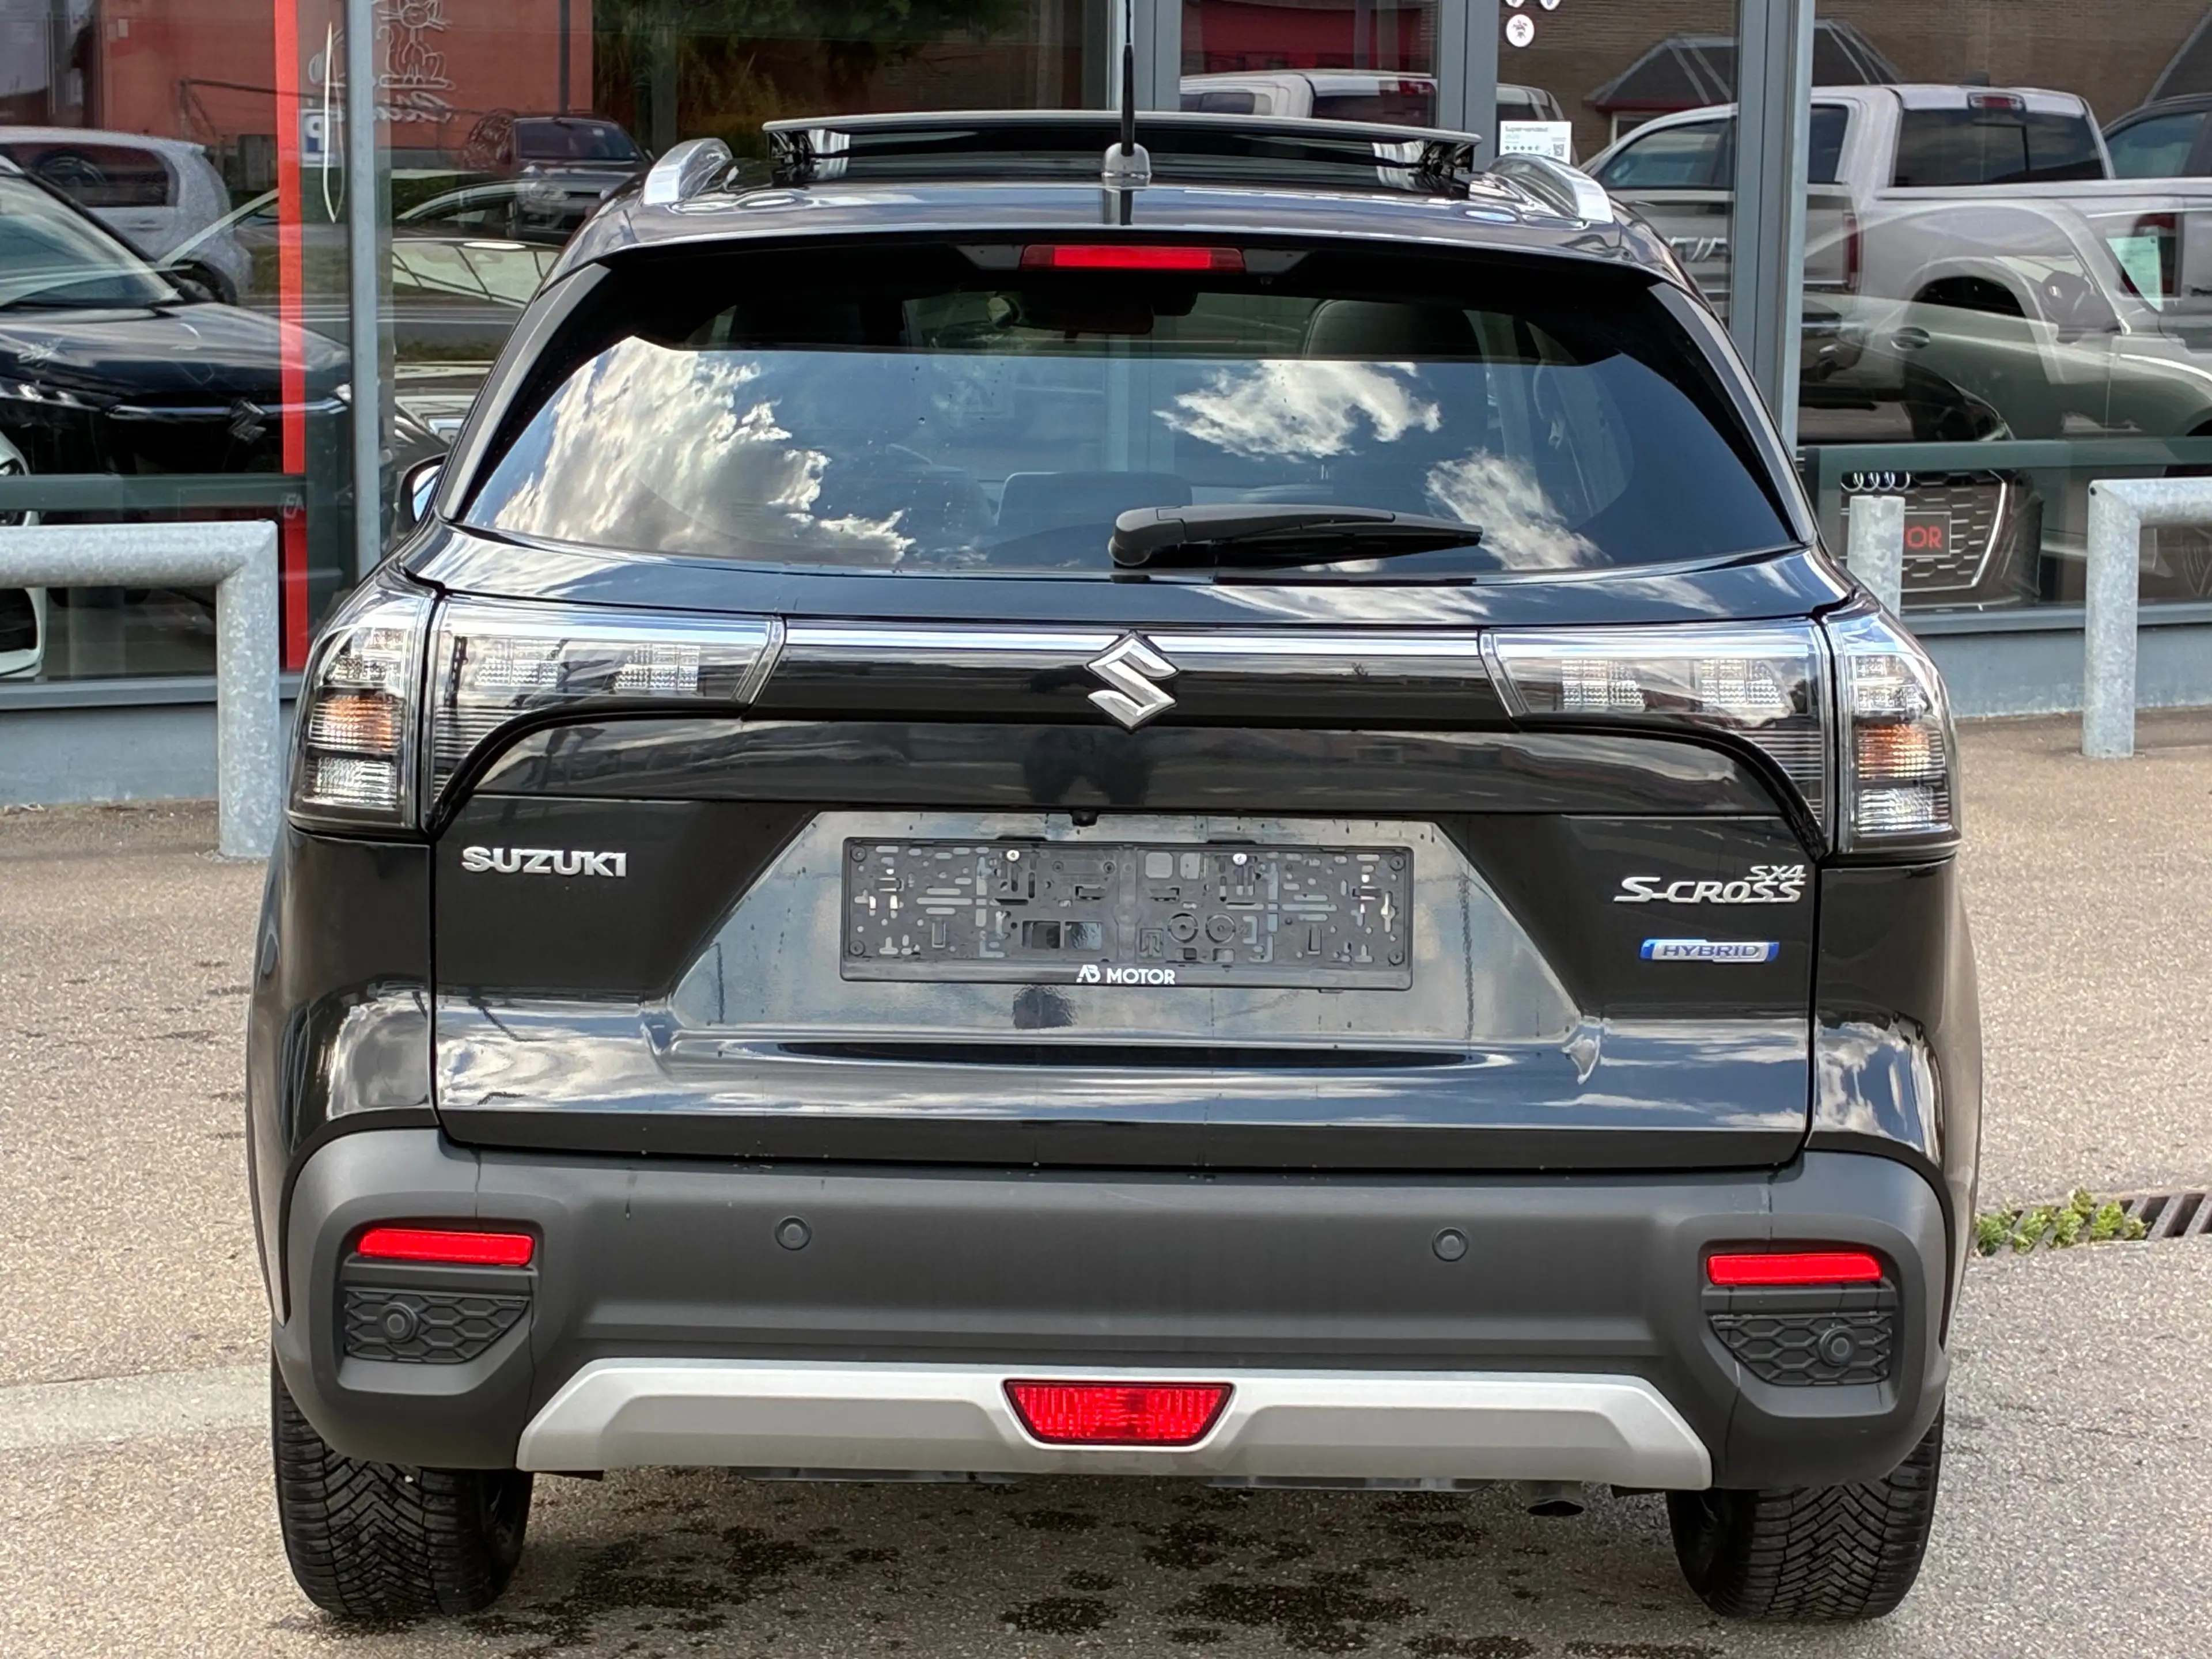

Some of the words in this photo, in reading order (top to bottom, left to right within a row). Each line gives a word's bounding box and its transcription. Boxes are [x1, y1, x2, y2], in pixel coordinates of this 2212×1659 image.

[1903, 525, 1943, 550] OR
[461, 846, 627, 877] SUZUKI
[1744, 864, 1807, 882] SX4
[1613, 876, 1805, 904] S-CROSS
[1662, 944, 1760, 957] HYBRID
[1106, 968, 1176, 985] MOTOR
